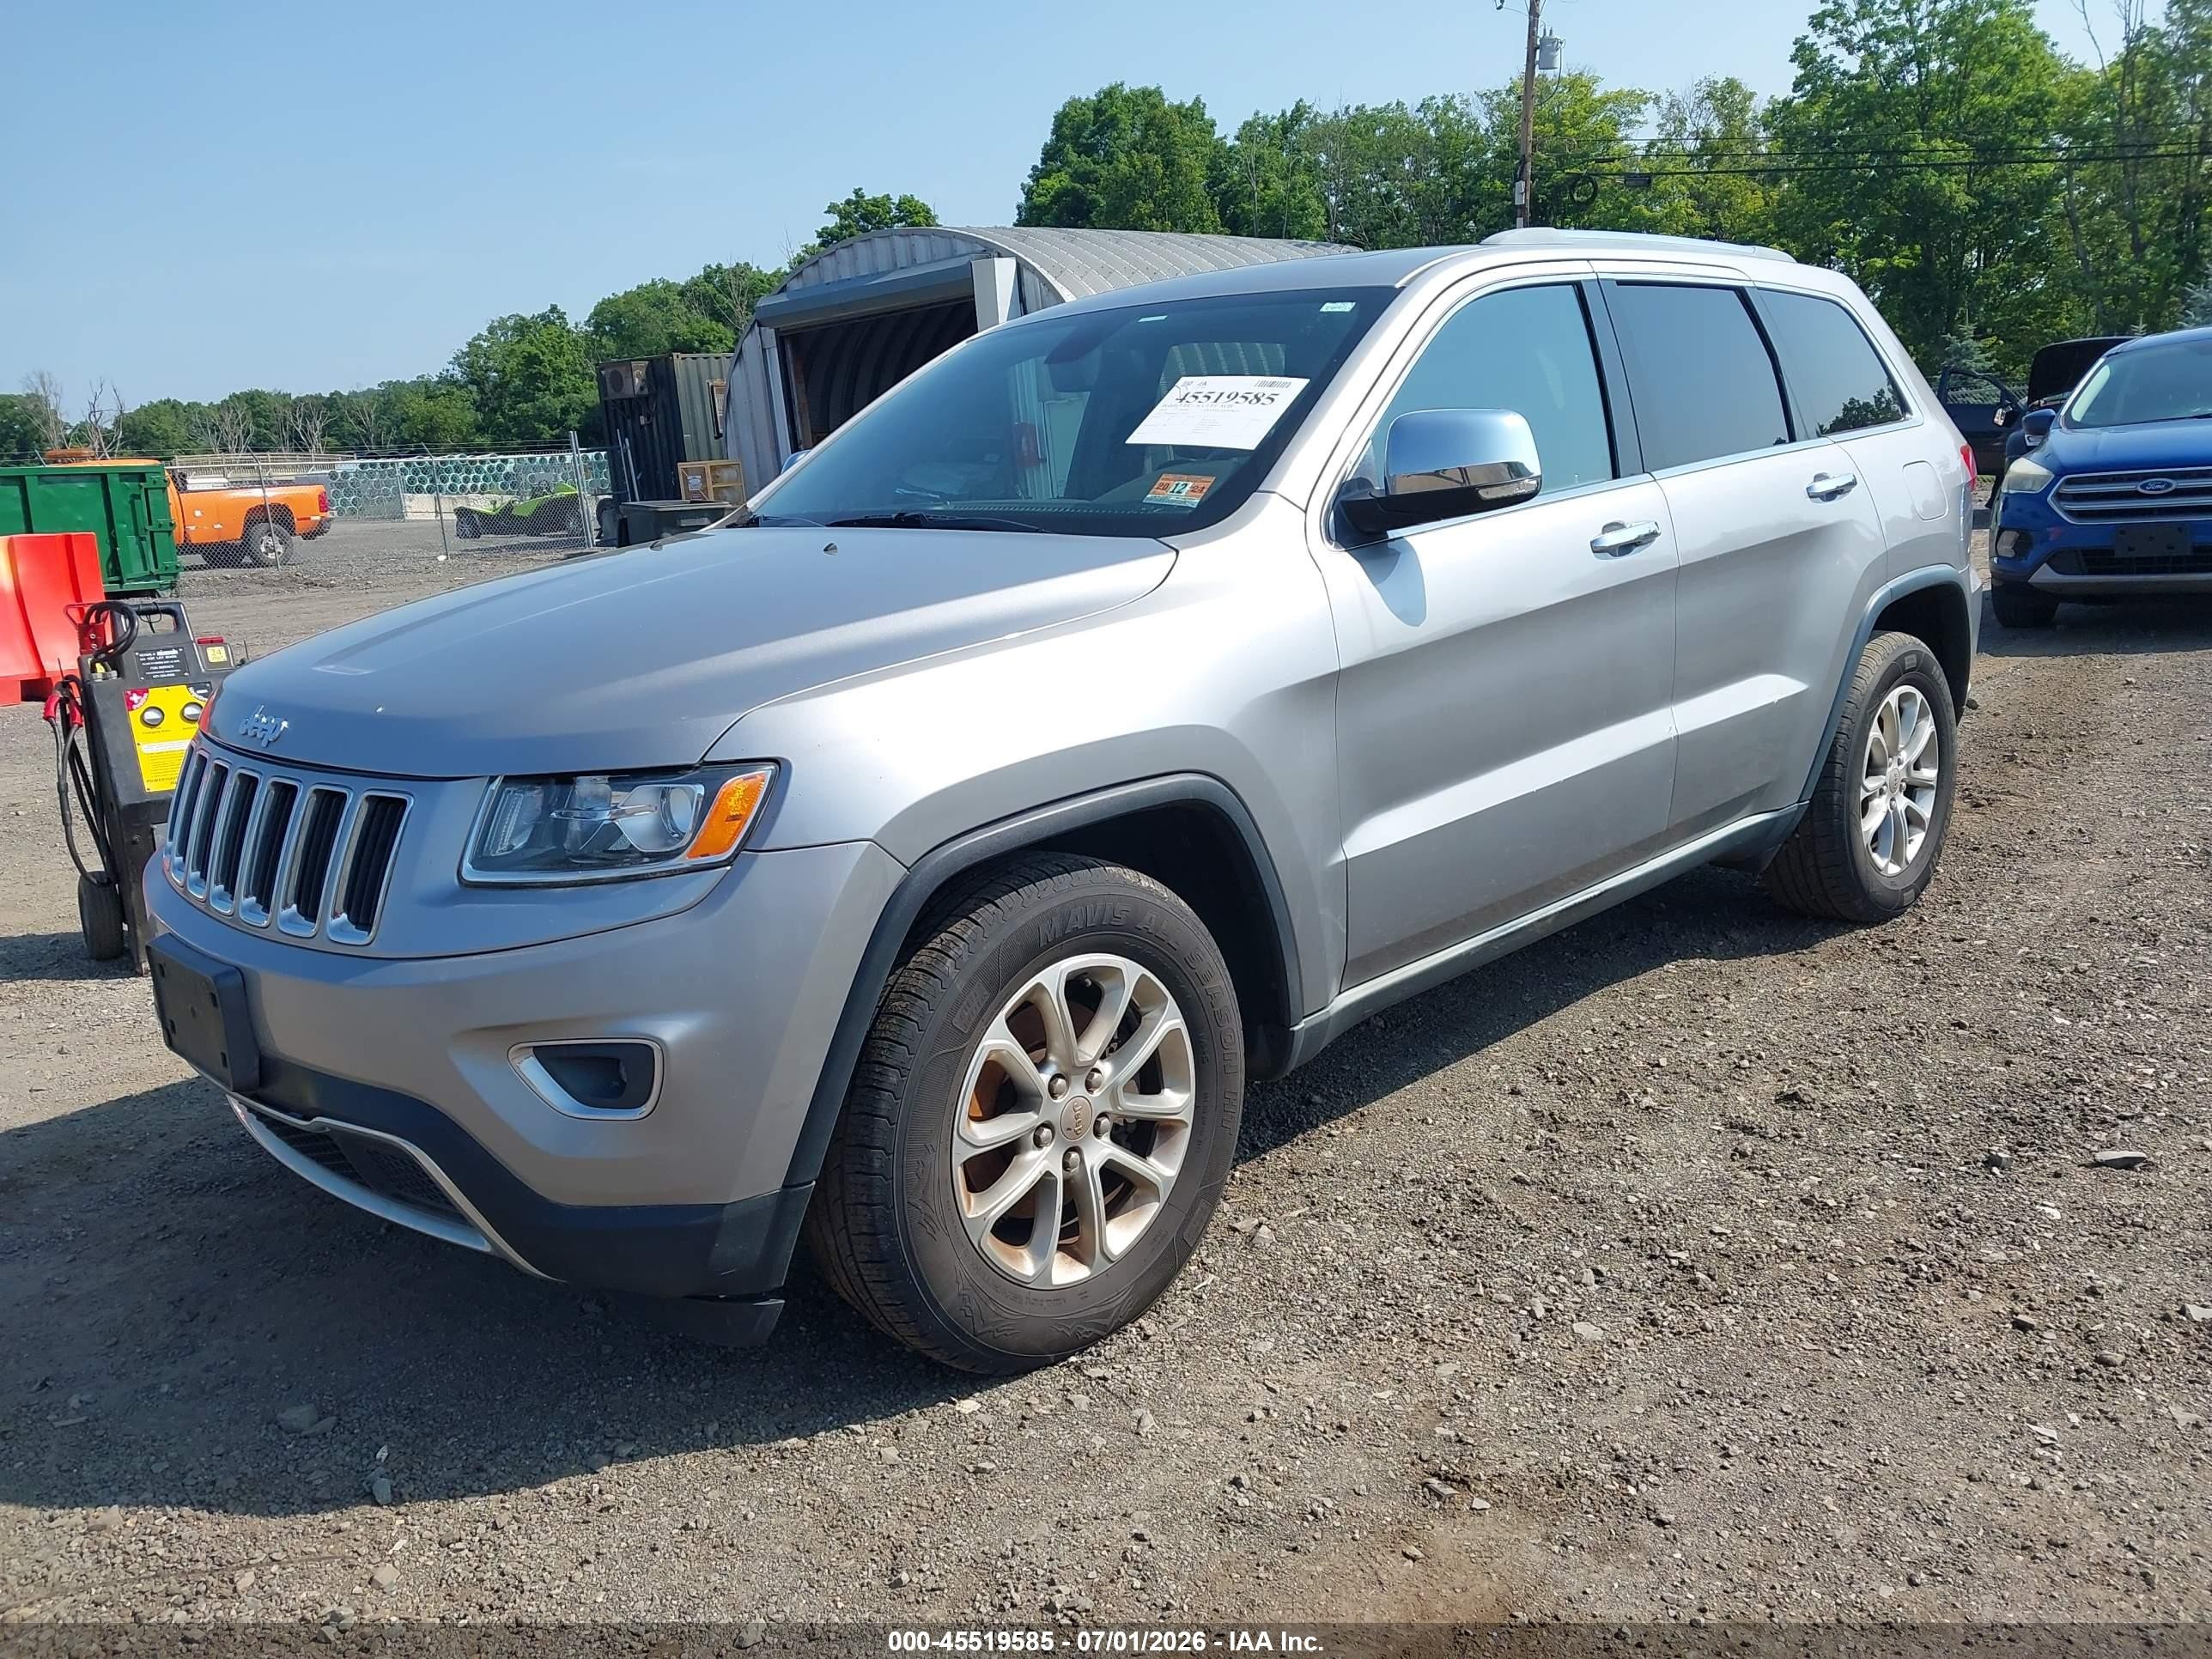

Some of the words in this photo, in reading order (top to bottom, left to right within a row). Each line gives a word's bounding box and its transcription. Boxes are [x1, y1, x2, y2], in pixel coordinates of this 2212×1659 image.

[1176, 392, 1280, 406] 45519585
[1170, 482, 1188, 495] 12
[240, 704, 289, 748] Jeep
[1039, 902, 1131, 949] MAVIS
[1134, 911, 1183, 952] ALL
[1184, 946, 1238, 1076] SEASON
[1221, 1091, 1239, 1136] HT
[1072, 1101, 1083, 1136] Jeep
